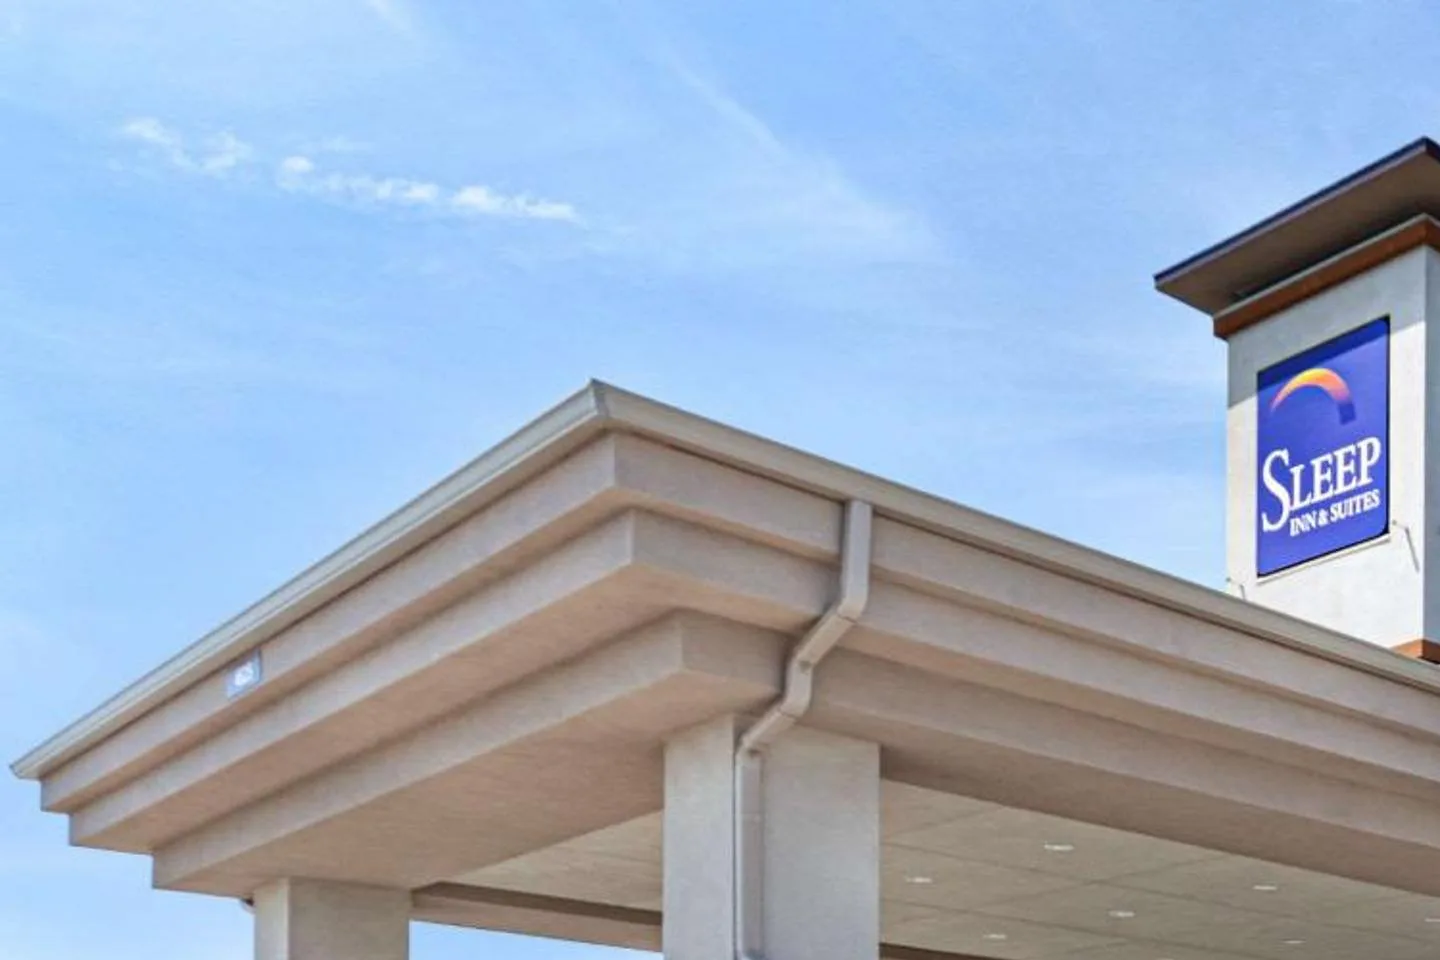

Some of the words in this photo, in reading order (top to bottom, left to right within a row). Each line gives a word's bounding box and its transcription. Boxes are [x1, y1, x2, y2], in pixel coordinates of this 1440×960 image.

[1261, 436, 1382, 532] SLEEP
[1290, 510, 1317, 537] INN
[1318, 508, 1329, 527] &
[1330, 488, 1380, 522] SUITES
